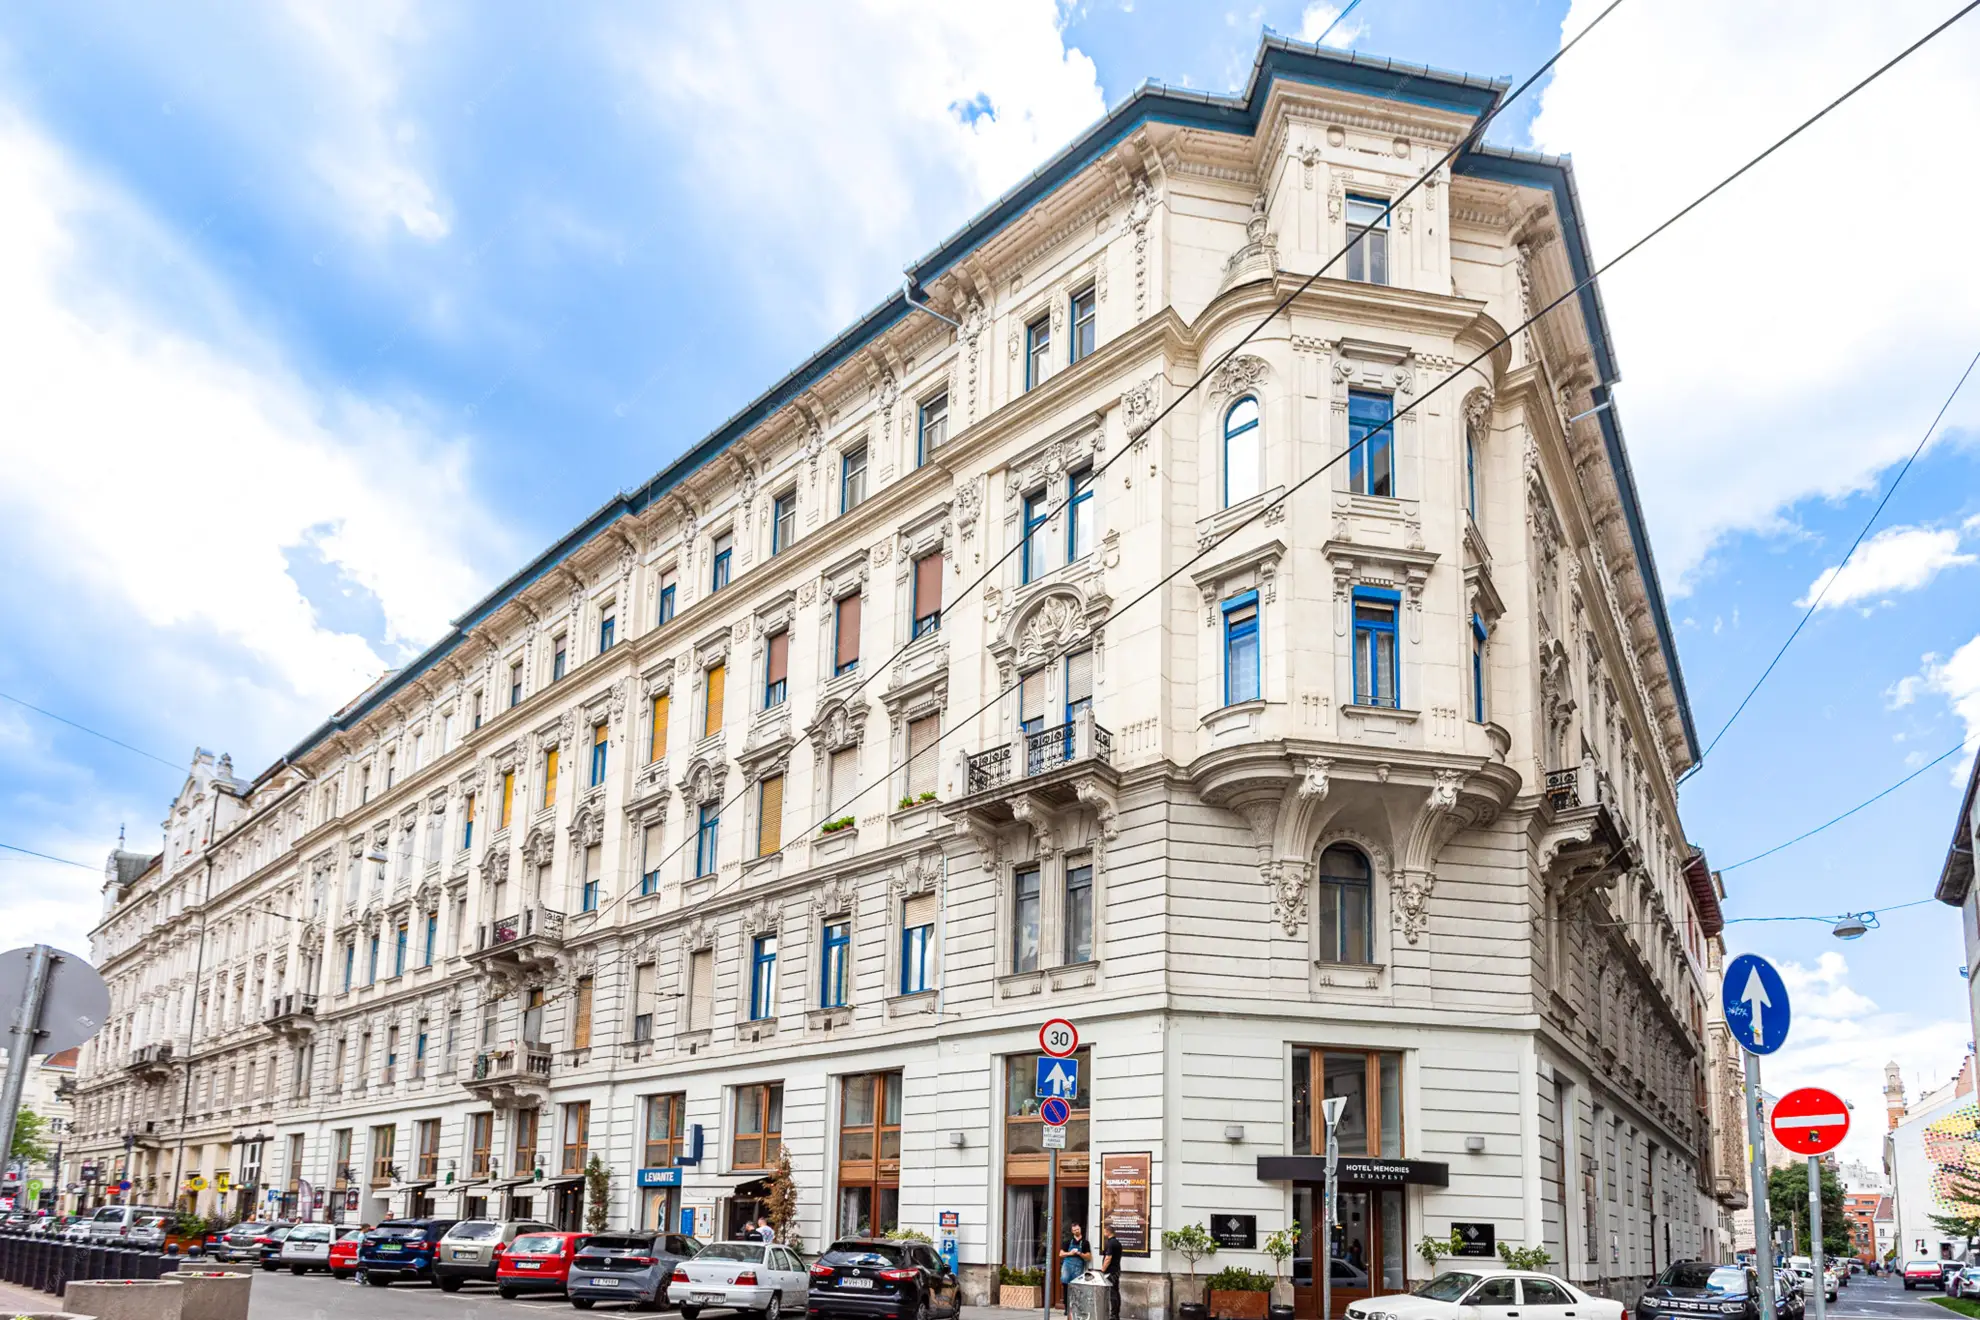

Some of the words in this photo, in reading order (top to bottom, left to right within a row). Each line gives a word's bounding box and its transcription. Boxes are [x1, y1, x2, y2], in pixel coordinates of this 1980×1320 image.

[1050, 1031, 1069, 1046] 30
[1345, 1164, 1372, 1172] HOTEL
[1373, 1165, 1410, 1174] MEMORIES
[644, 1171, 675, 1183] LEVANTE
[1353, 1173, 1405, 1181] BUDAPEST
[843, 1277, 872, 1289] MVH-191
